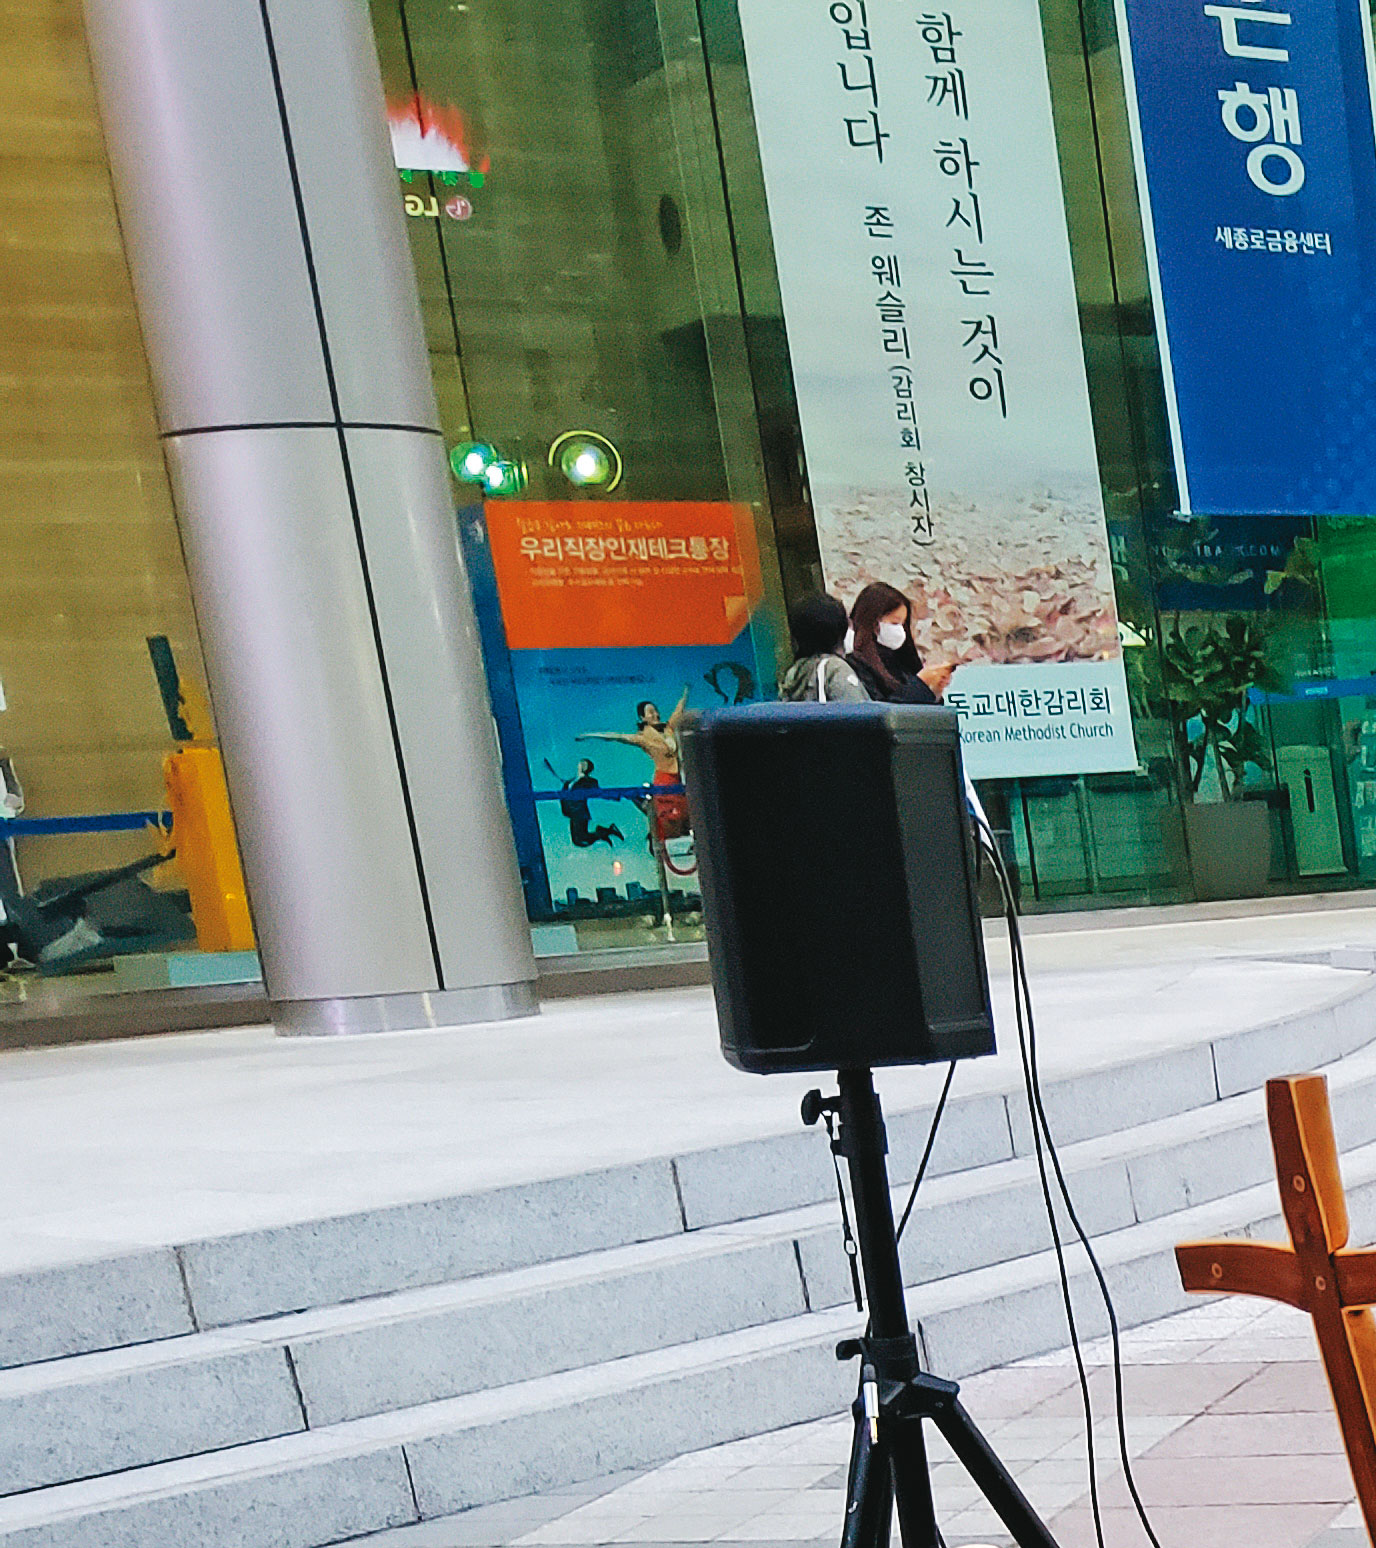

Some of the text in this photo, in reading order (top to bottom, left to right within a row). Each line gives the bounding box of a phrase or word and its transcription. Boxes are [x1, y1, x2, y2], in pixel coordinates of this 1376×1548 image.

[915, 12, 1007, 419] 함께 하시는 것이
[1215, 226, 1333, 256] 세종로금융센터
[829, 0, 891, 164] 입니다
[863, 205, 895, 239] 존
[904, 461, 937, 547] 창시자)
[947, 687, 1112, 719] 독교대한감리회
[1005, 724, 1067, 742] Methodist
[1070, 722, 1114, 738] Church
